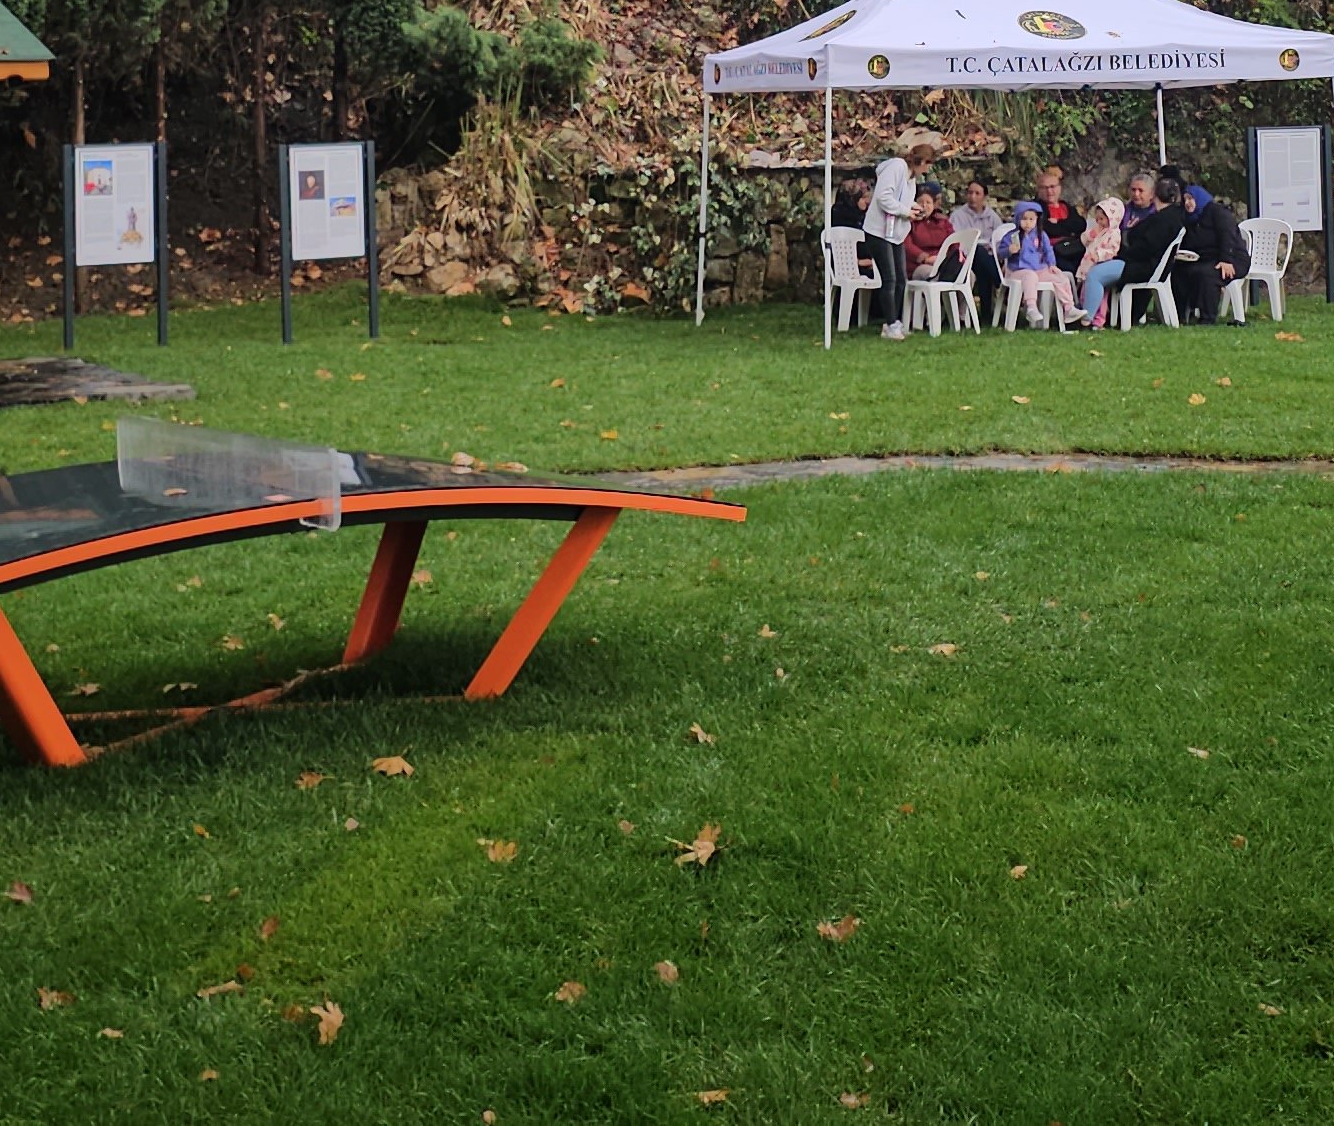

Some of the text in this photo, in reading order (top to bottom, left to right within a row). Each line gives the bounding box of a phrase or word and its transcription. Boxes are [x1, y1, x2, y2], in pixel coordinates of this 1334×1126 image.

[945, 48, 1226, 76] T.C. ÇATALAĞZI BELEDİYESİ
